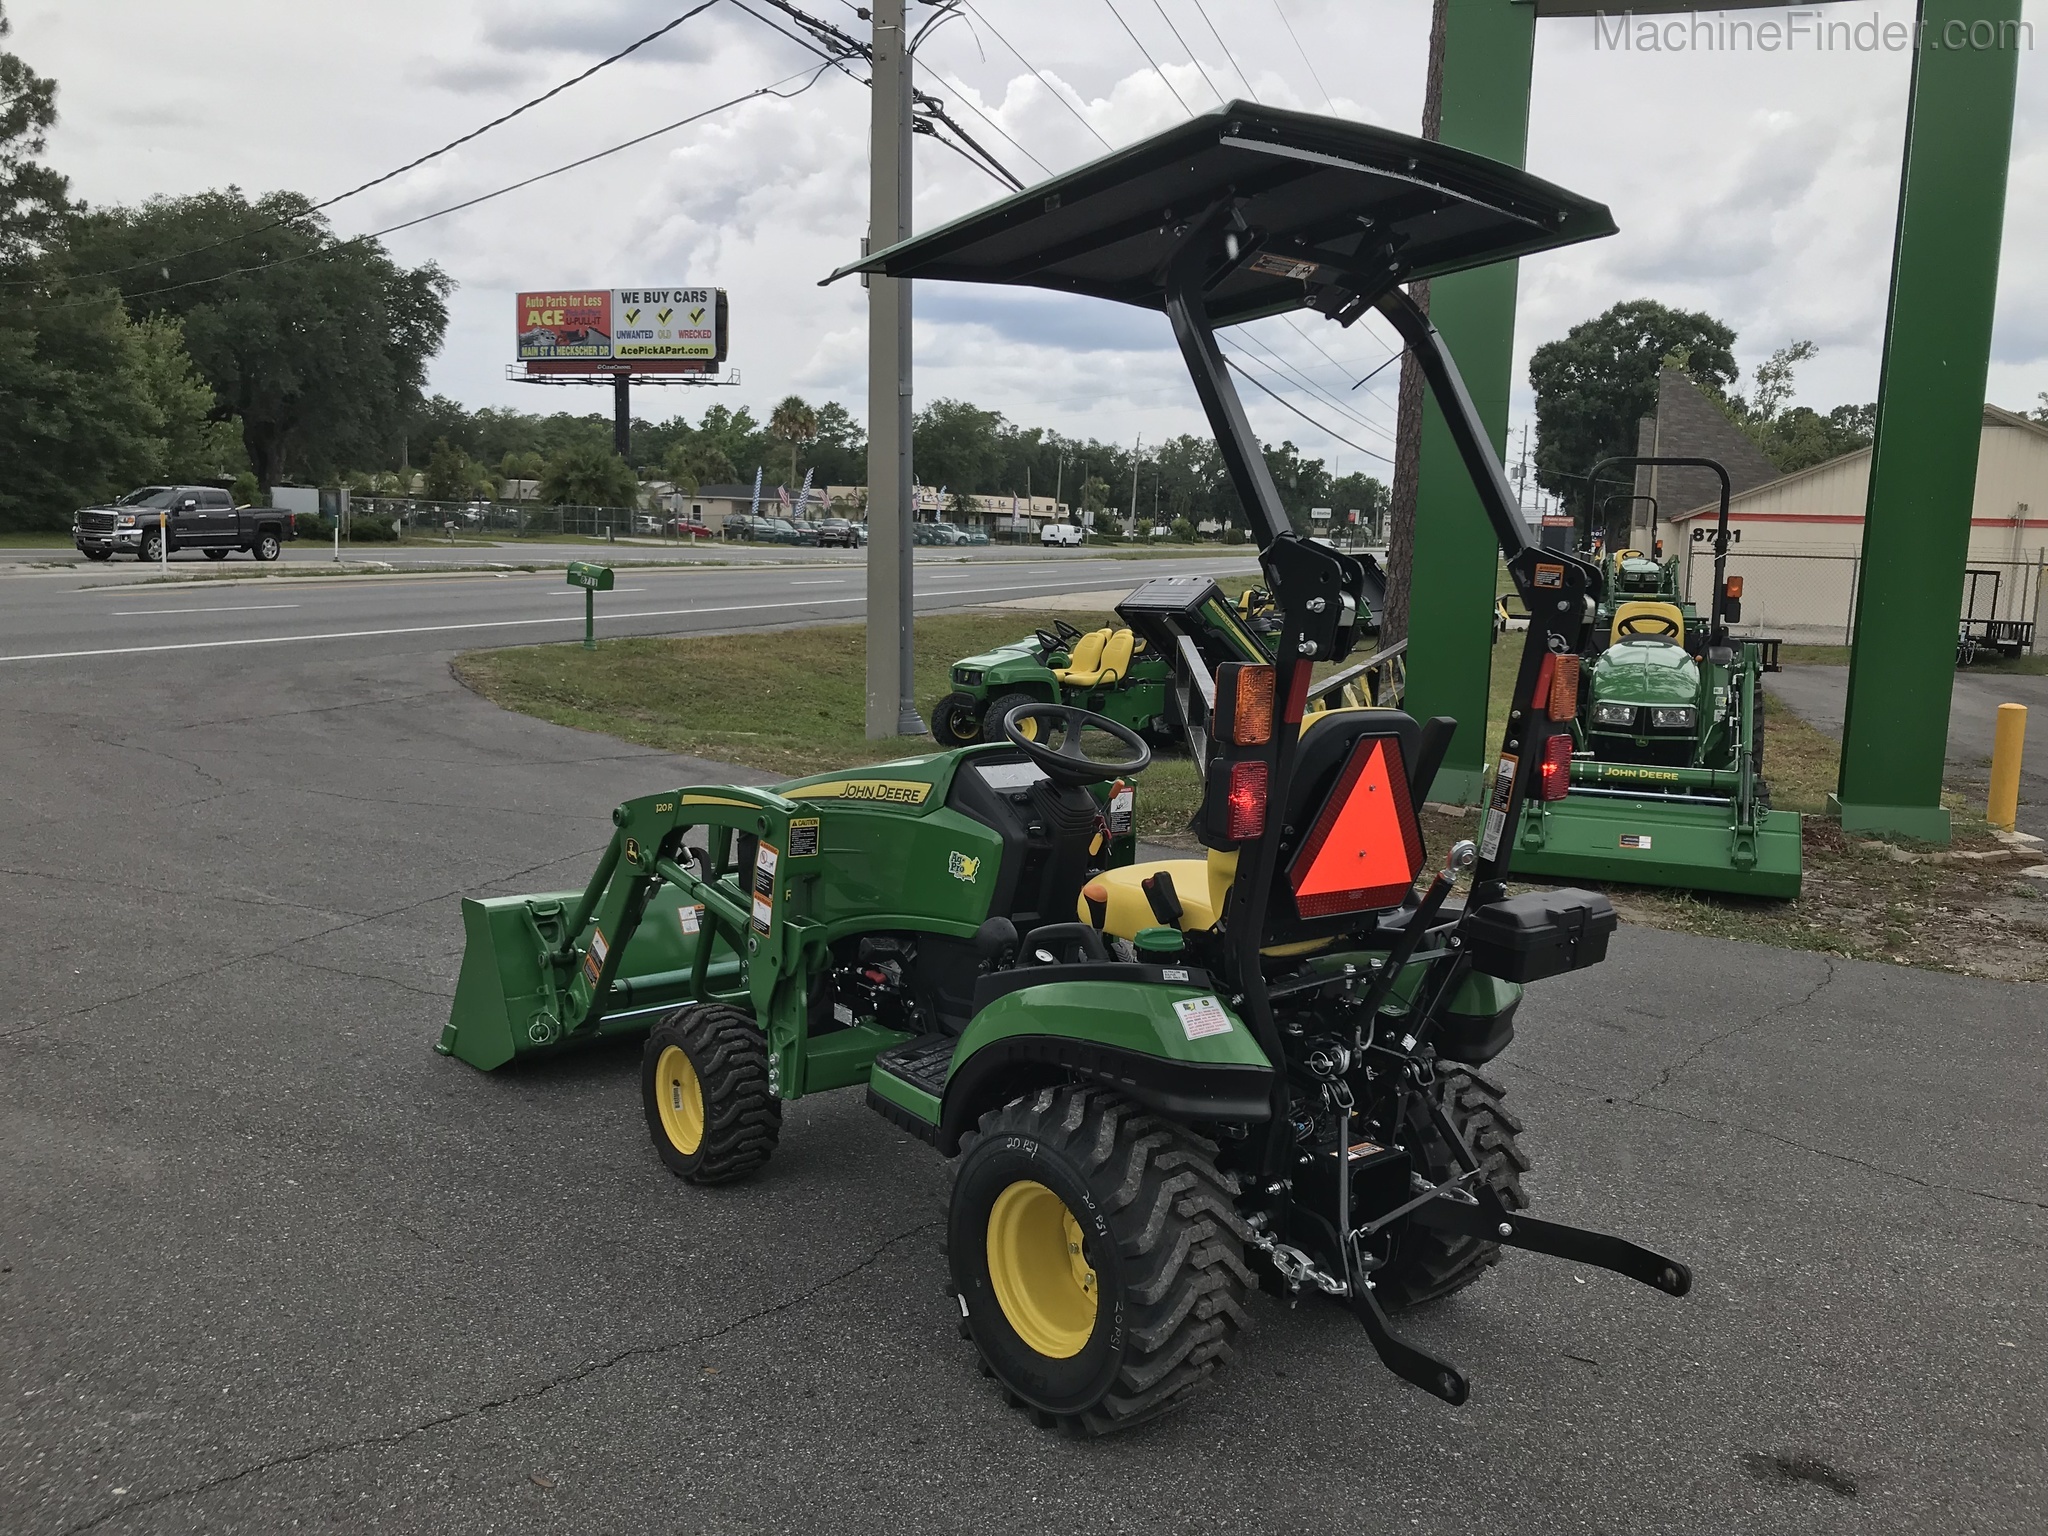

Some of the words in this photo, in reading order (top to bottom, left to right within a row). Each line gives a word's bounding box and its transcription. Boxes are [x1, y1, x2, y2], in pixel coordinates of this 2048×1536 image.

[526, 296, 544, 308] Auto
[546, 295, 567, 307] Parts
[569, 295, 581, 306] for
[583, 295, 602, 306] Less
[621, 292, 640, 303] WE
[644, 291, 669, 303] BUY
[674, 291, 707, 303] CARS
[527, 310, 565, 326] ACE
[566, 317, 602, 325] U-PULL-IT
[616, 330, 654, 339] UNWANTED
[657, 330, 672, 339] OLD
[678, 330, 712, 339] WRECKED
[521, 346, 538, 356] MAIN
[539, 346, 549, 356] ST
[550, 346, 555, 356] &
[556, 345, 597, 356] HECKSCHER
[599, 345, 609, 355] DR
[620, 346, 709, 355] AcePickAPart.com
[1604, 767, 1637, 778] JOHN
[1639, 769, 1679, 781] DEERE
[839, 783, 874, 798] JOHN
[876, 784, 921, 802] DEERE
[798, 819, 818, 827] CAUTION
[950, 862, 965, 873] Pro
[1006, 1137, 1021, 1149] 20
[1022, 1139, 1039, 1159] PSI
[1082, 1190, 1096, 1210] 20
[1095, 1214, 1108, 1237] PSI
